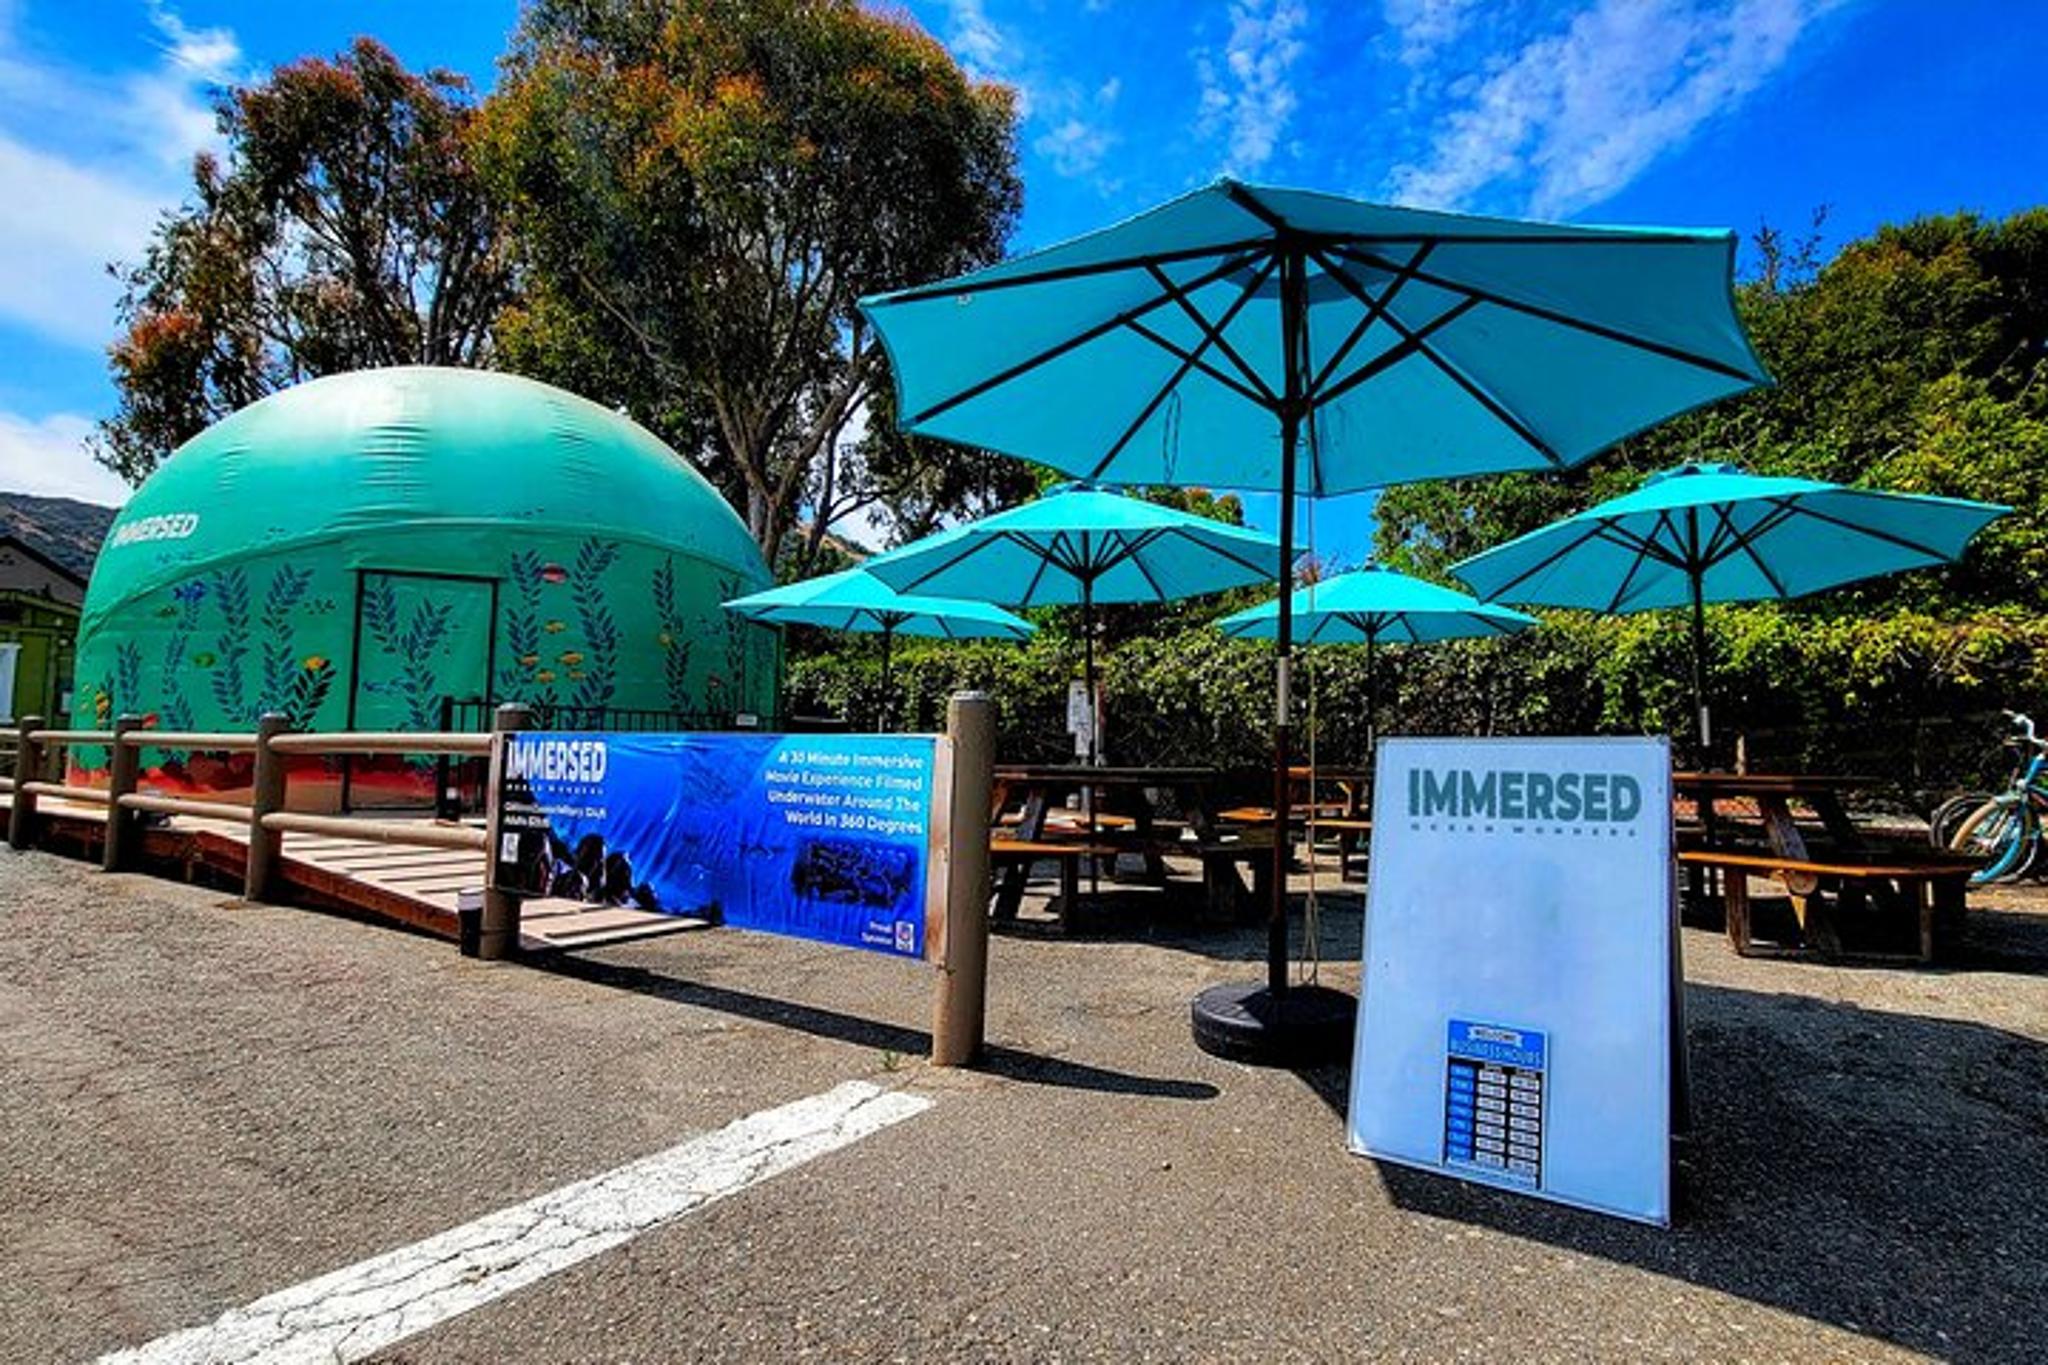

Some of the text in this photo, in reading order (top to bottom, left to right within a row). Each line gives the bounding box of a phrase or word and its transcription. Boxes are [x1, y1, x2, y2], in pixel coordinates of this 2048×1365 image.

[111, 513, 199, 549] IMMERSED
[506, 740, 607, 783] IMMERSED
[778, 751, 790, 763] A
[807, 752, 850, 766] Minute
[853, 753, 923, 769] Immersive
[765, 770, 922, 791] Movie Experience Filmed
[767, 790, 921, 812] Underwater Around The
[1408, 769, 1642, 822] IMMERSED
[785, 810, 823, 826] World
[839, 814, 865, 829] 360
[867, 816, 923, 836] Degrees
